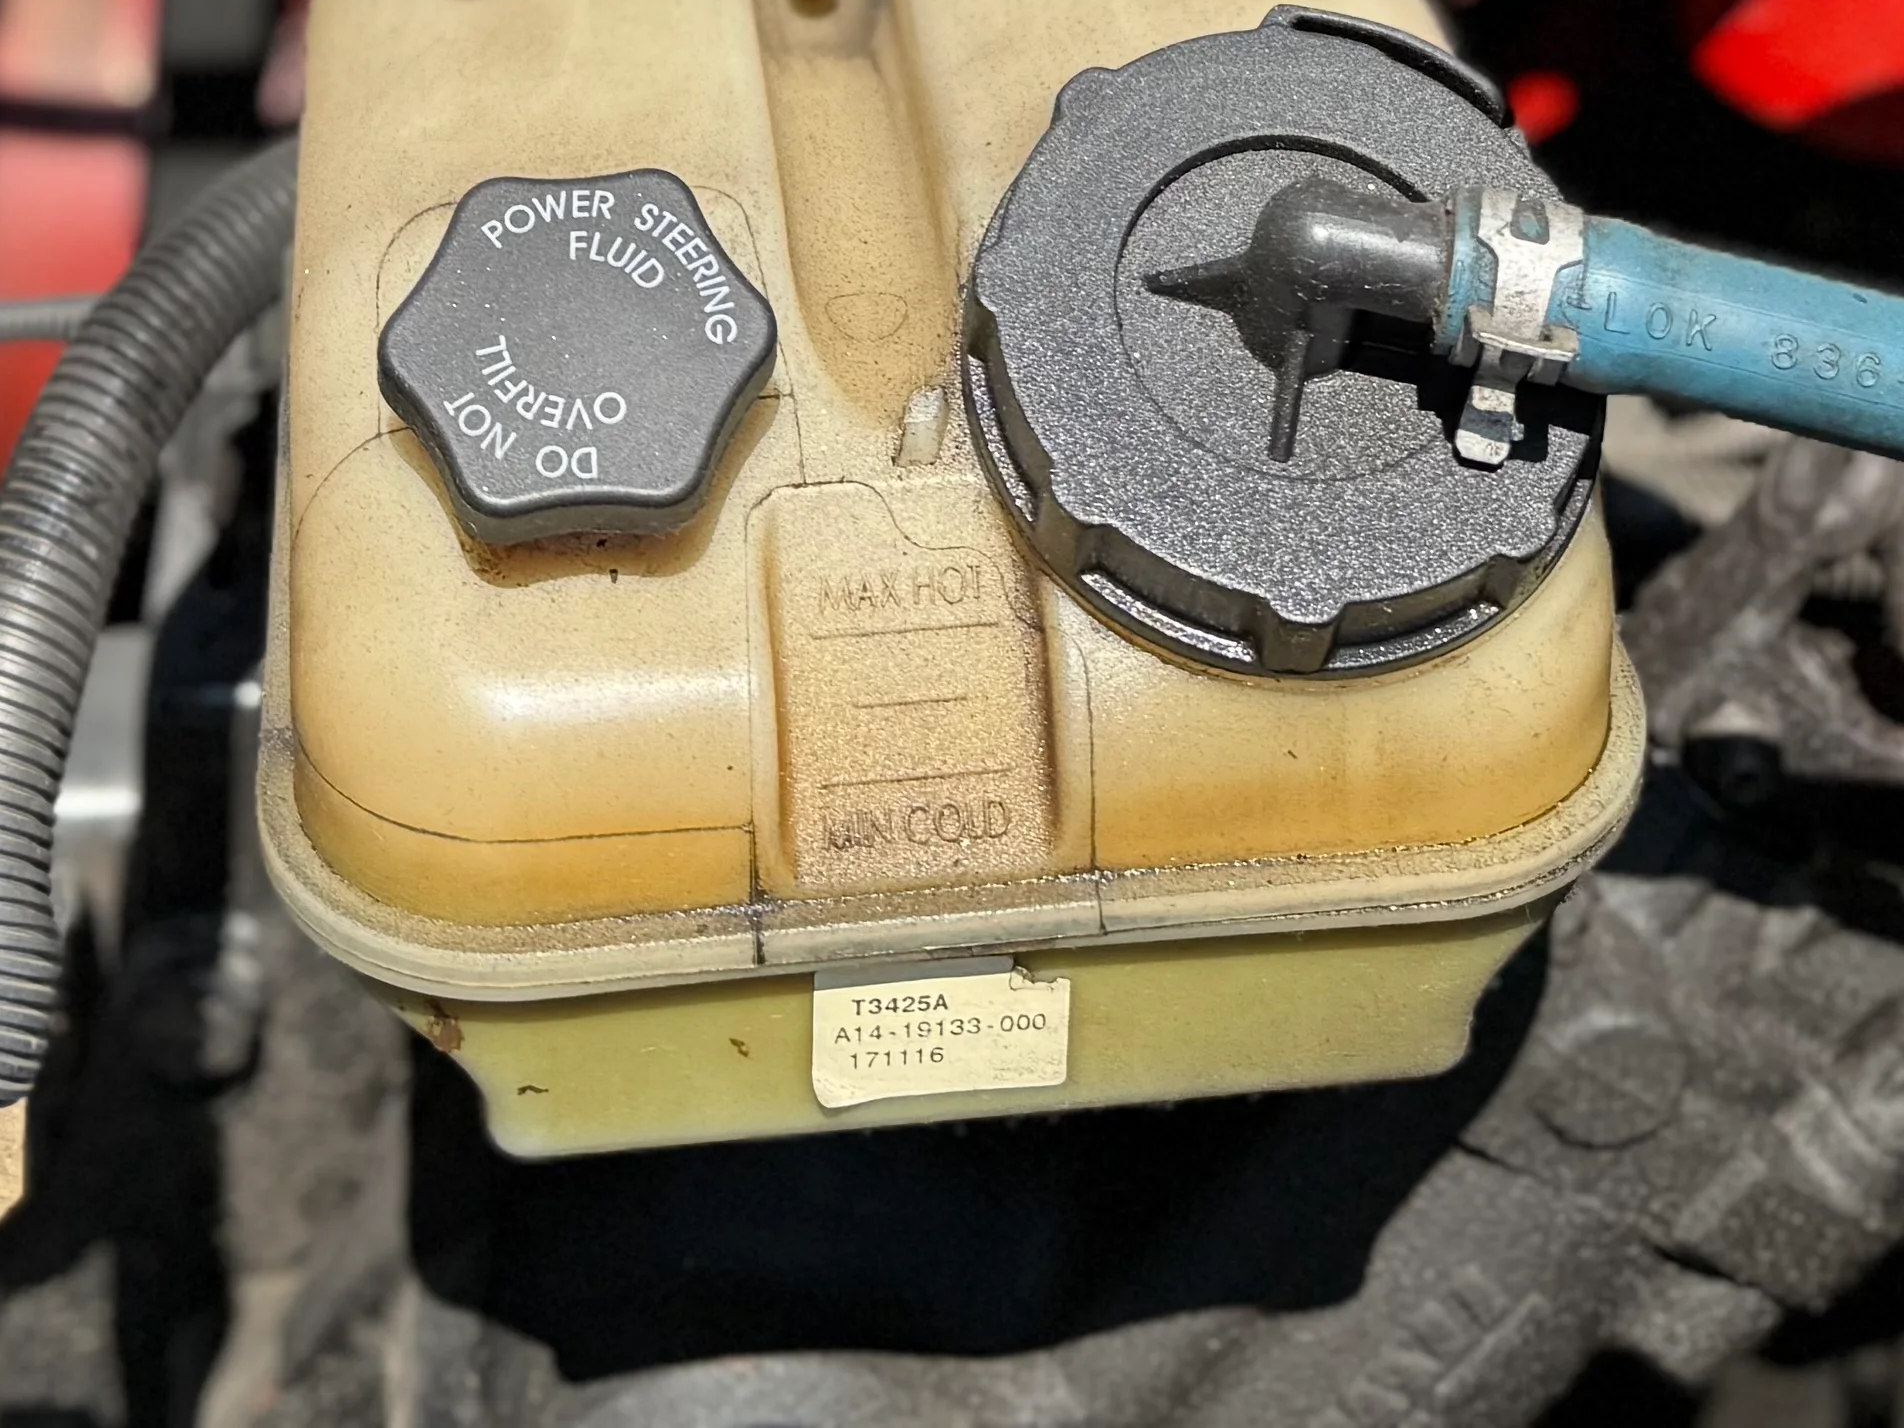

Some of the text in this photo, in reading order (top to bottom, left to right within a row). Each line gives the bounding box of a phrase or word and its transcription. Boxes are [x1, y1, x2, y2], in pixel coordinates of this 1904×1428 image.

[481, 190, 739, 346] POWER STEERING
[568, 229, 665, 291] FLUID
[474, 333, 628, 427] OVERFILL
[442, 389, 599, 480] DO NOT
[816, 563, 985, 617] MAX HOT
[820, 798, 1013, 854] MIN COLD
[834, 1011, 1048, 1047] A14-19133-000
[850, 991, 950, 1018] T3425A
[849, 1045, 945, 1072] 171116
